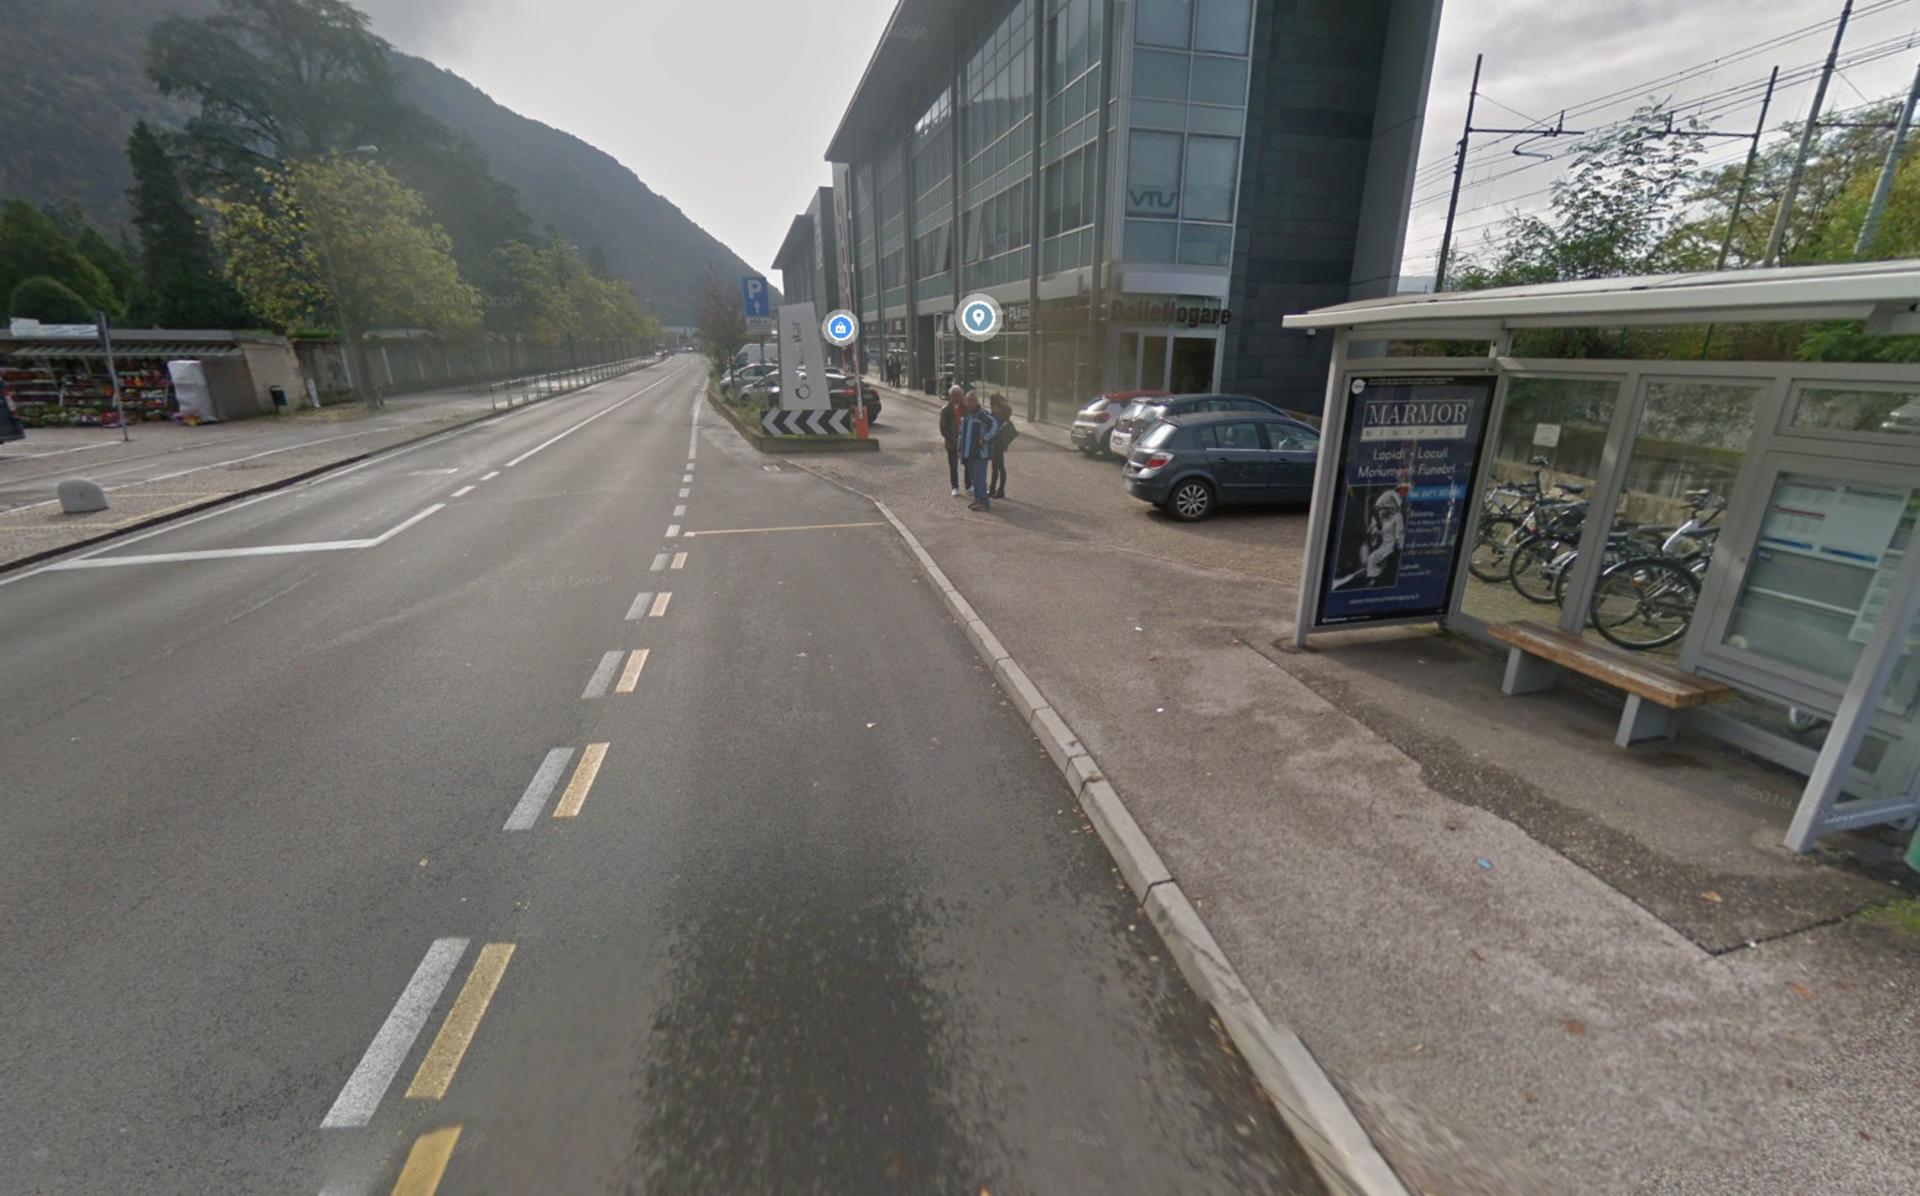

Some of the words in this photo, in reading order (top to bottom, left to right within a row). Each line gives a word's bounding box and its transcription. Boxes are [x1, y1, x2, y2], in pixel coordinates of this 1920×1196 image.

[1128, 189, 1177, 208] VTU
[747, 279, 762, 299] P
[1367, 403, 1467, 425] MARMOR
[1372, 447, 1406, 463] Lapidi
[1417, 446, 1449, 460] Loculi
[1418, 463, 1456, 476] Funebri
